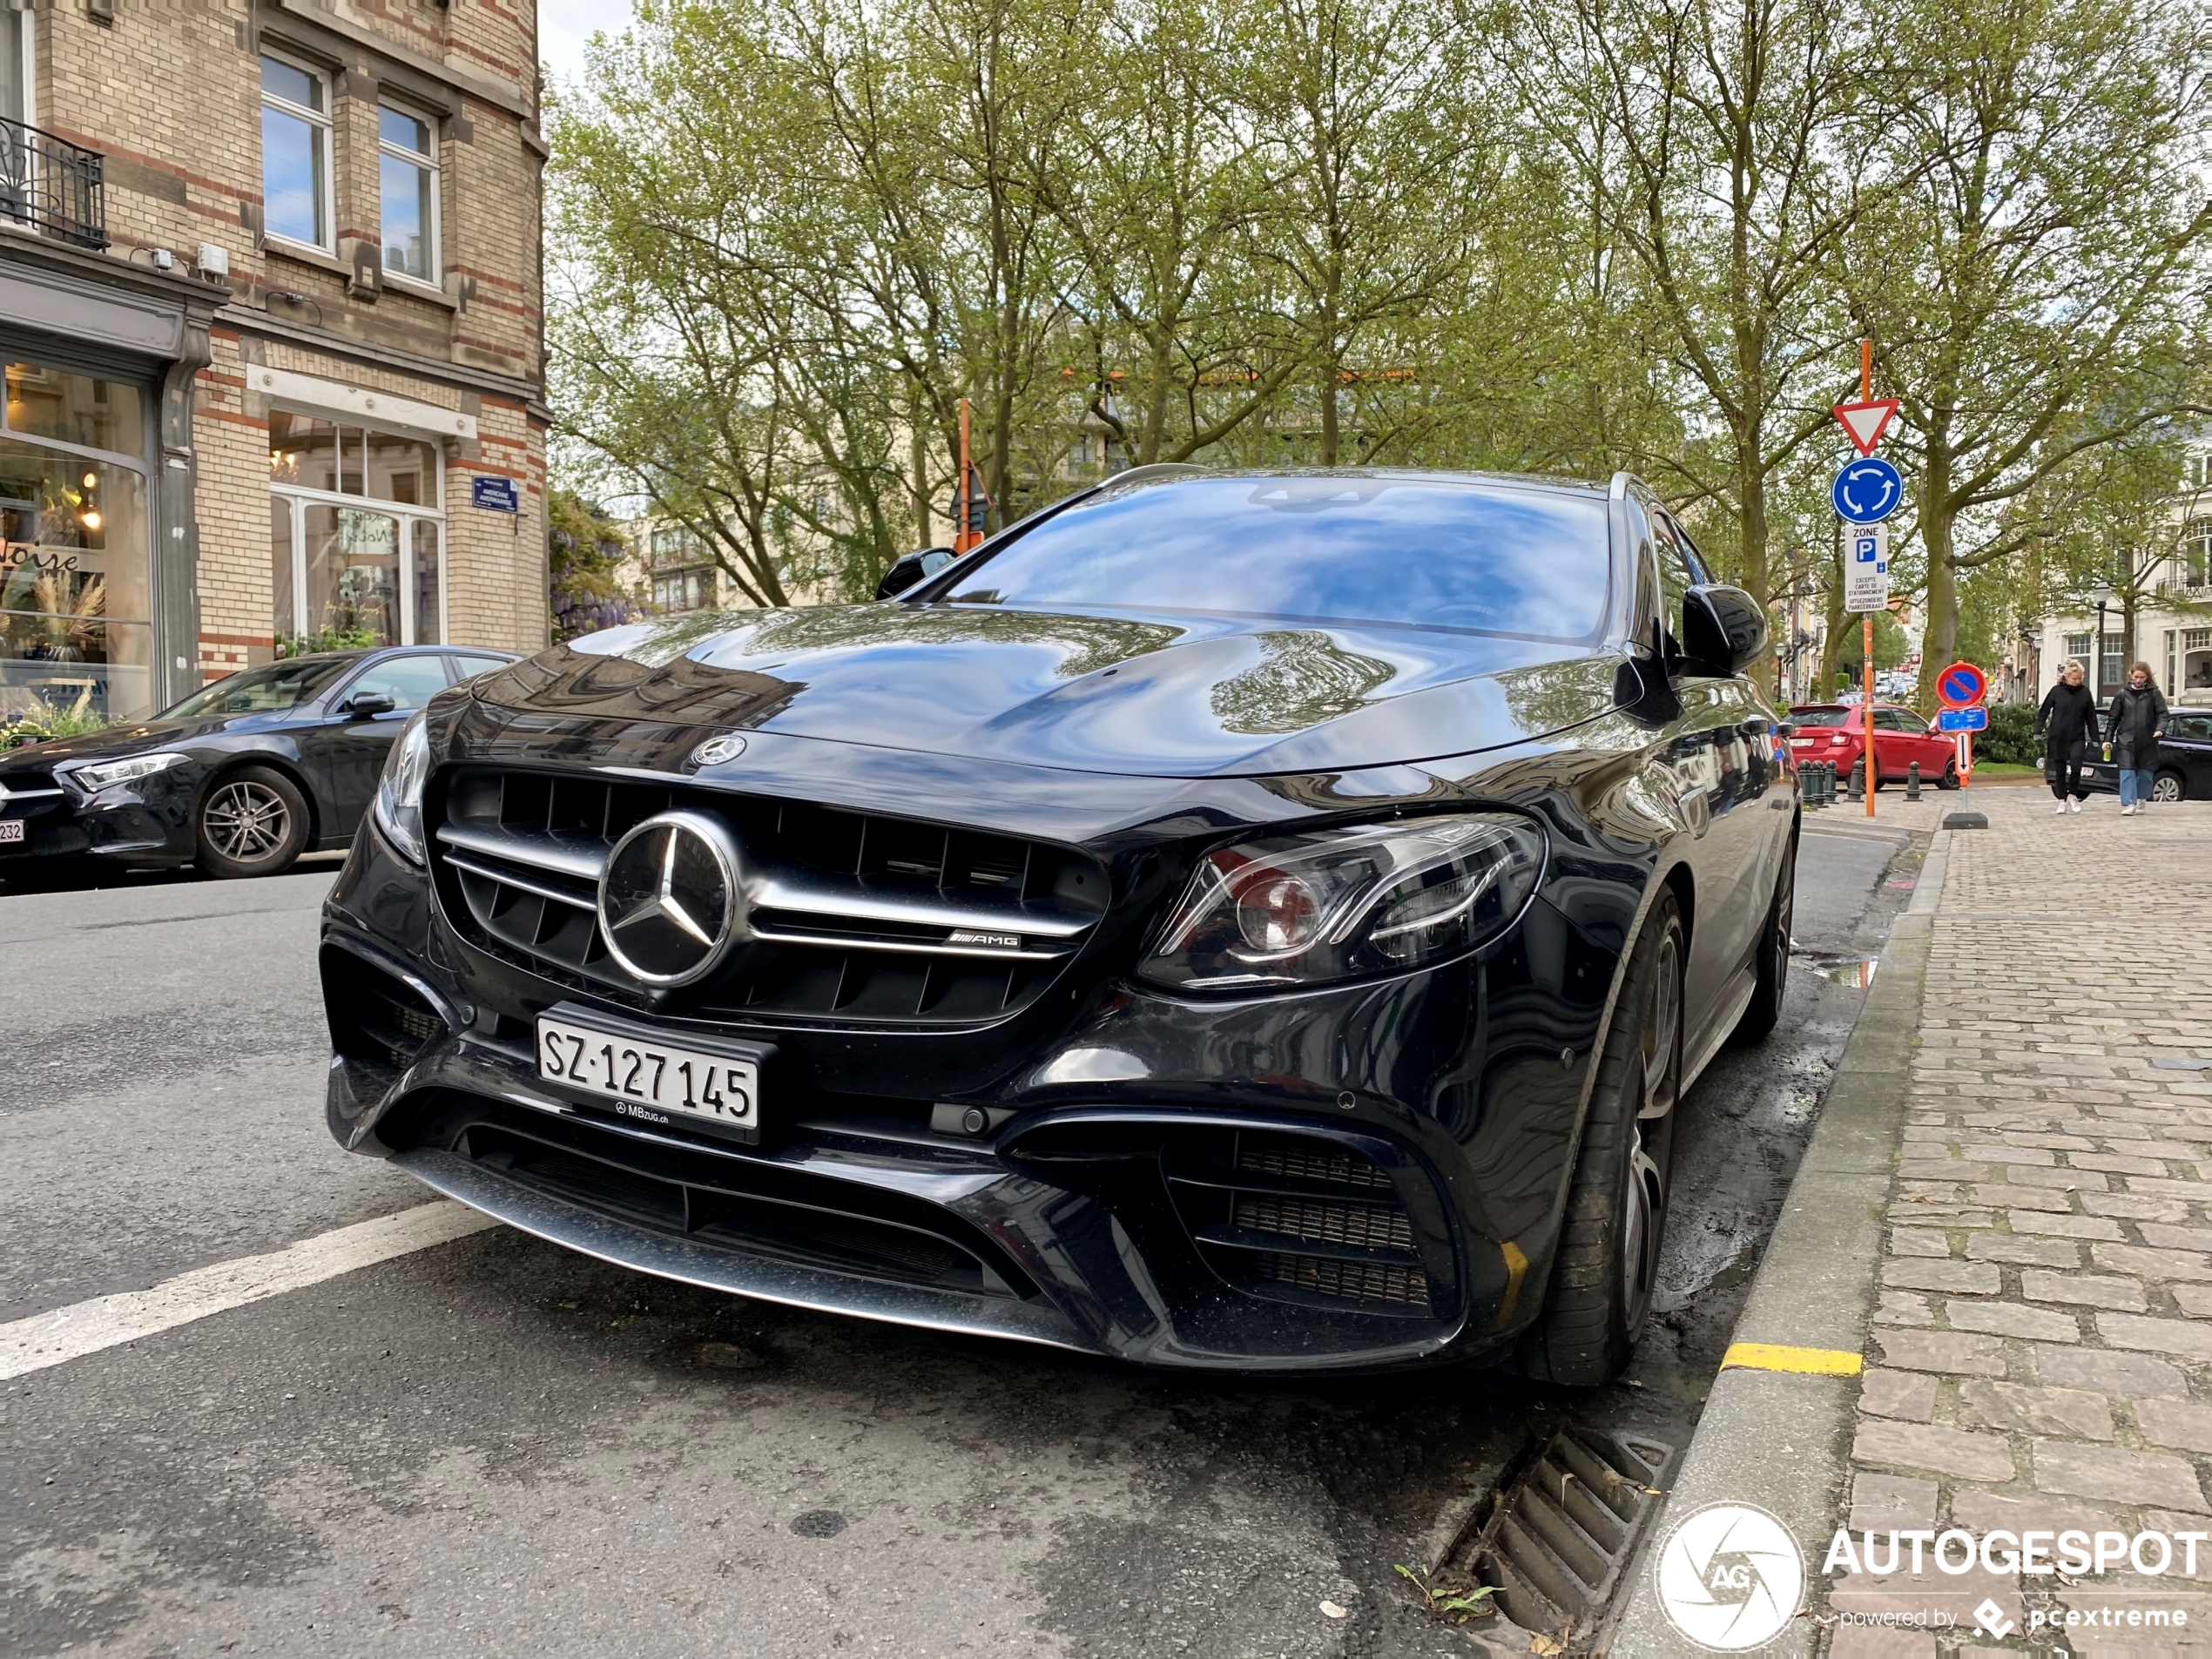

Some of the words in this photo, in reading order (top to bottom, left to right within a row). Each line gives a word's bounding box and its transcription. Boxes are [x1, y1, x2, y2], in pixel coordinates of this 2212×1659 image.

[1853, 528, 1878, 537] ZONE
[1859, 541, 1873, 560] P
[971, 934, 1018, 946] AMG
[678, 1060, 750, 1118] 145
